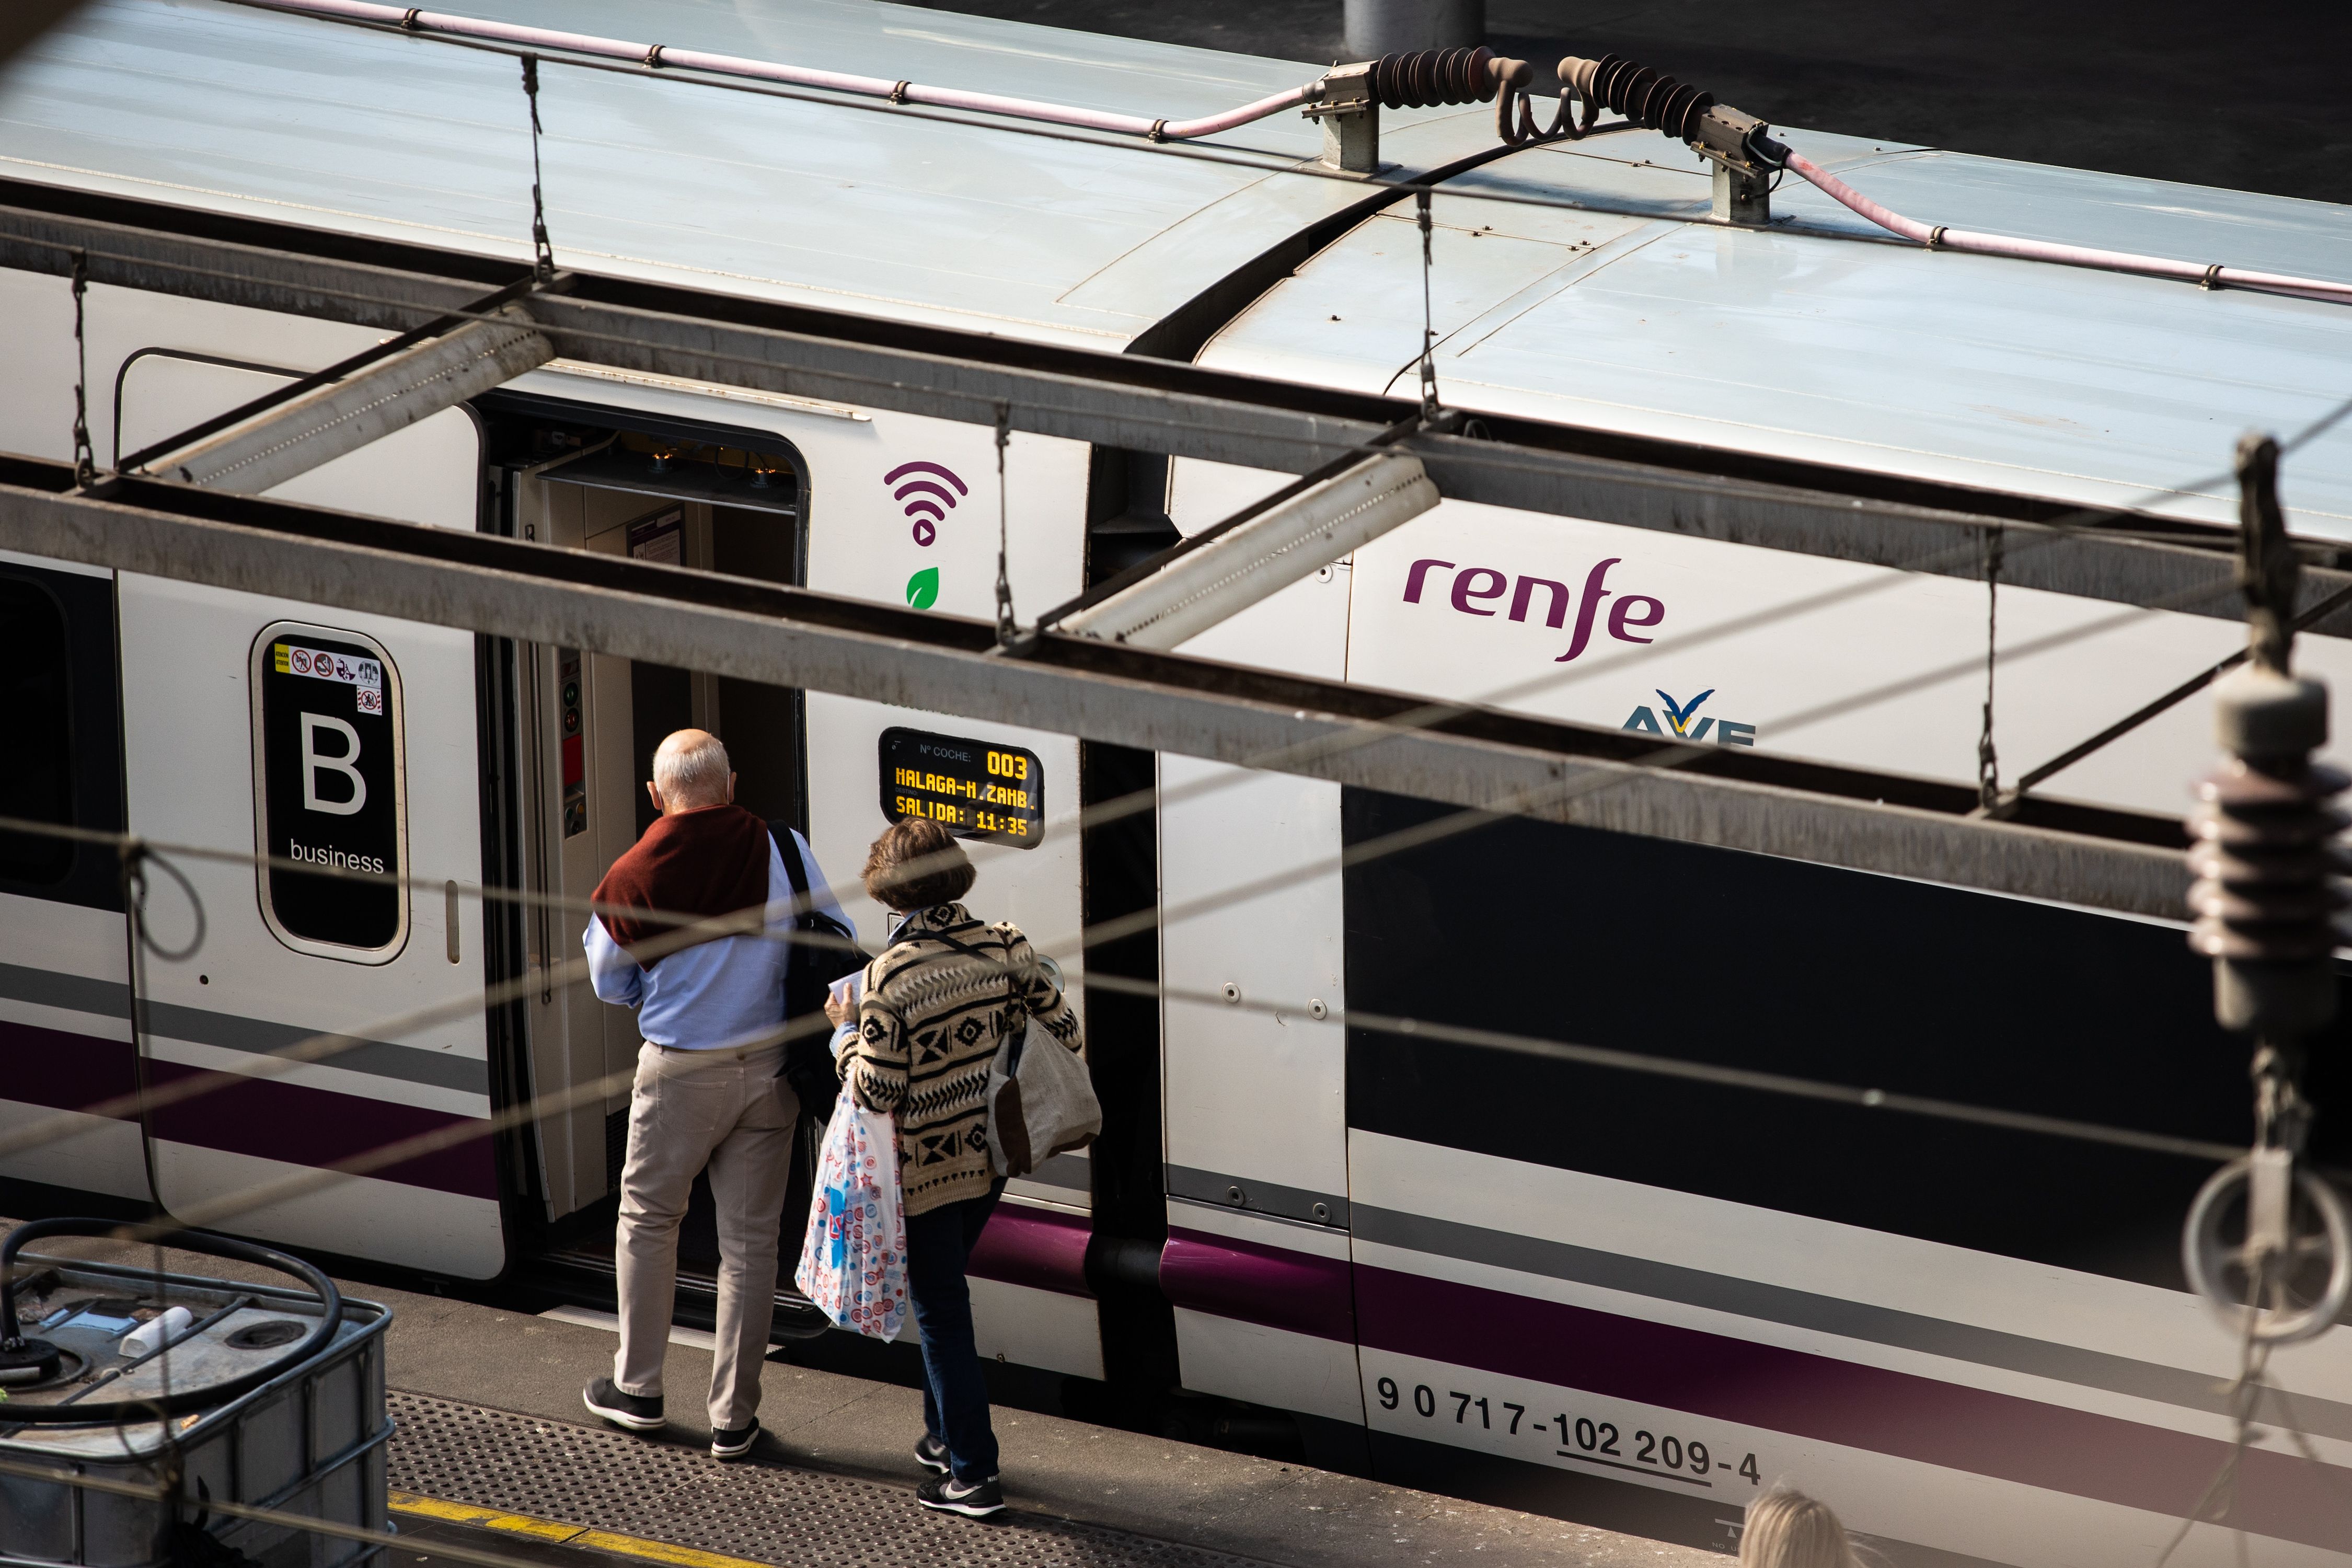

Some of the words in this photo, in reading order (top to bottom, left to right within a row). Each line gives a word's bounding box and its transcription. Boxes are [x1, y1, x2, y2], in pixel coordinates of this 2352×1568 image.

[1403, 558, 1665, 662] renfe
[301, 712, 366, 815] B
[933, 747, 971, 762] COCHE:
[987, 751, 1028, 780] 003
[895, 787, 919, 796] DESTINO:
[896, 796, 964, 824] SALIDA:
[976, 811, 1028, 837] 11:35
[291, 838, 384, 874] business
